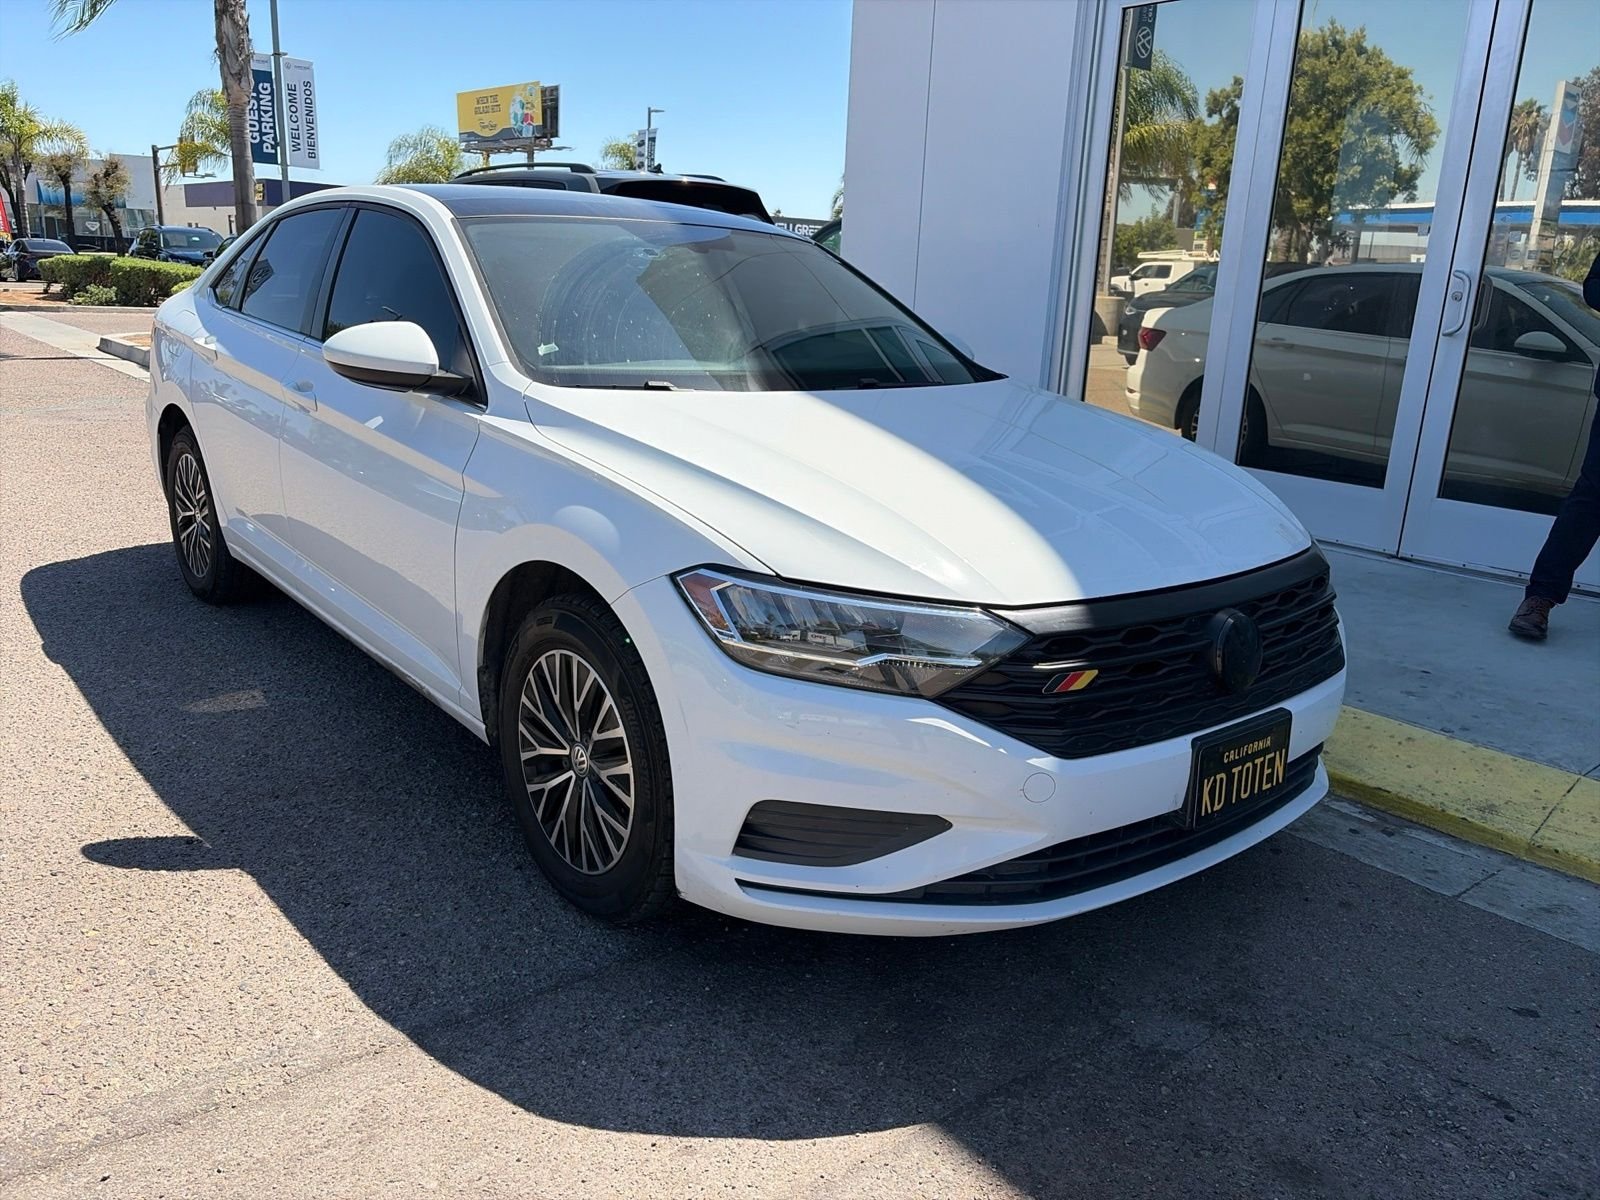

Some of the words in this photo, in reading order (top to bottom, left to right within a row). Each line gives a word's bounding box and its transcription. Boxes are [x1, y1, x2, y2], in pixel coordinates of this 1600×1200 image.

[258, 82, 275, 153] PARKING
[287, 82, 301, 153] WELCOME
[303, 80, 316, 159] BIENVENIDOS
[1201, 773, 1226, 816] KD
[1232, 749, 1285, 804] TOTEN
[1223, 736, 1271, 763] CALIFORNIA
